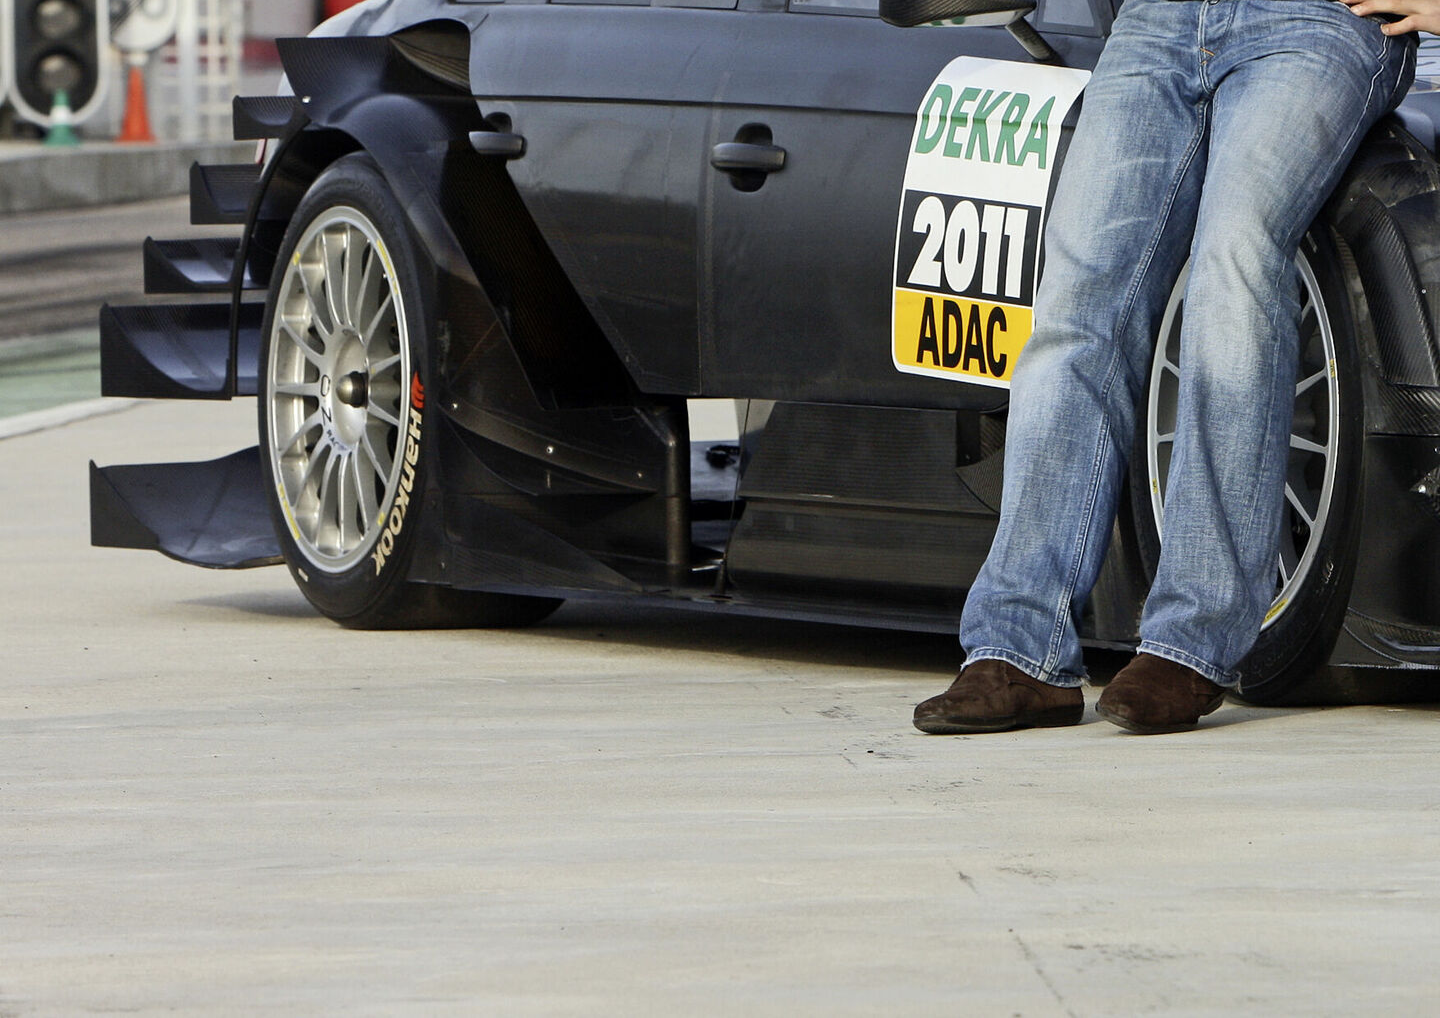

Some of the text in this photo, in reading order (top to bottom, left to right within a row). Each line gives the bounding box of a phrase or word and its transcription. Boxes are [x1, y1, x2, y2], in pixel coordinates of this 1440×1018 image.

[914, 84, 1056, 169] DEKRA
[907, 196, 1028, 299] 2011
[916, 297, 1008, 378] ADAC
